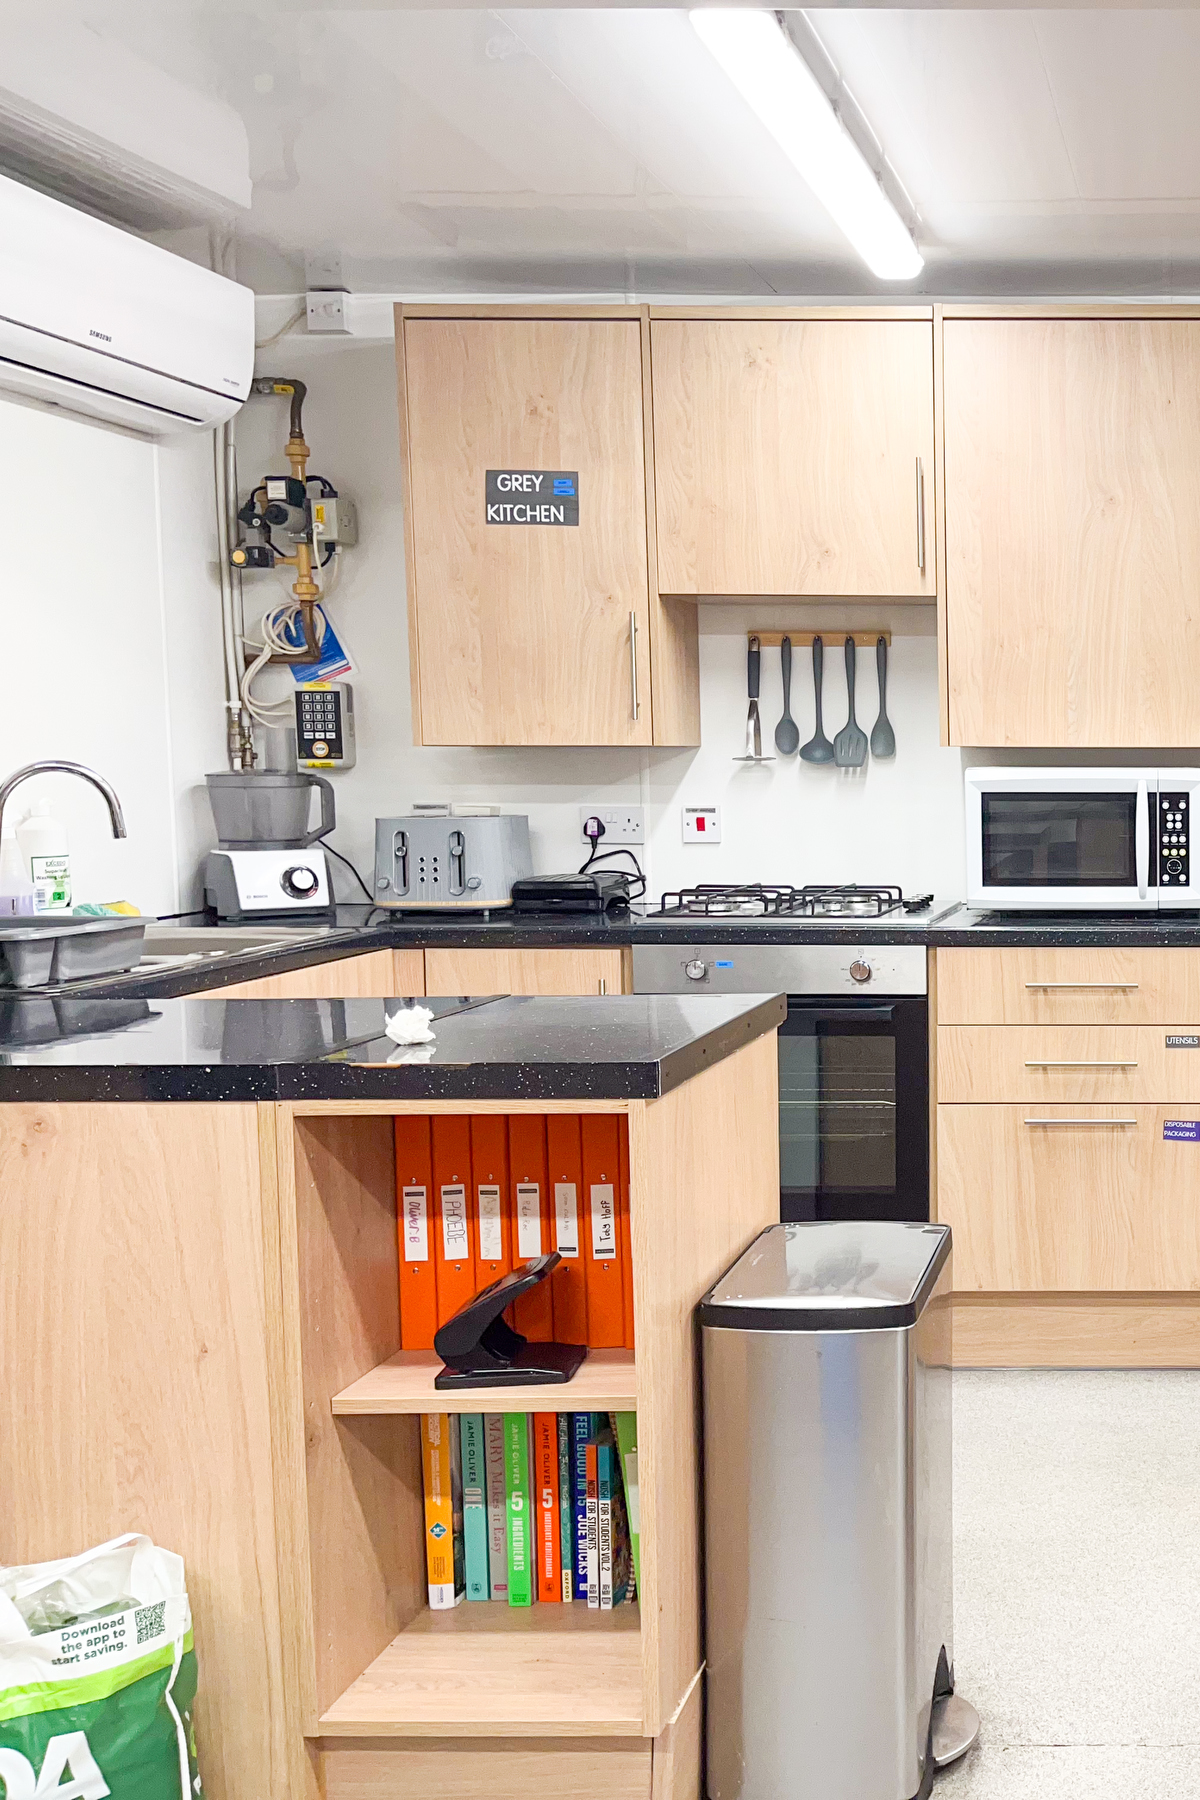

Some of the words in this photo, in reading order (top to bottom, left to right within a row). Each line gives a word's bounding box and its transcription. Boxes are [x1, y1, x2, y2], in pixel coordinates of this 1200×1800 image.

[89, 329, 112, 343] SAMSUNG
[496, 474, 544, 492] GREY
[487, 504, 564, 522] KITCHEN
[444, 1201, 466, 1245] PHOEBE
[467, 1420, 476, 1448] JAMIE
[511, 1423, 520, 1450] JAMIE
[542, 1422, 550, 1450] JAMIE
[576, 1416, 588, 1440] FEEL
[488, 1418, 503, 1468] MARY
[468, 1450, 476, 1482] OLIVER
[512, 1452, 520, 1484] OLIVER
[543, 1453, 551, 1485] OLIVER
[512, 1491, 523, 1512] 5
[542, 1488, 553, 1508] 5
[587, 1480, 596, 1498] NOSH
[600, 1480, 610, 1498] NOSH
[588, 1501, 596, 1514] FOR
[600, 1502, 610, 1516] FOR
[492, 1527, 505, 1554] Easy
[512, 1517, 524, 1570] INGREDIENTS
[588, 1516, 597, 1550] STUDENTS
[601, 1518, 610, 1552] STUDENTS
[578, 1539, 588, 1575] WICKS
[61, 1615, 124, 1642] Download
[61, 1642, 82, 1654] the
[86, 1634, 110, 1647] app
[113, 1629, 126, 1638] to
[52, 1654, 80, 1666] start
[84, 1642, 128, 1660] saving.
